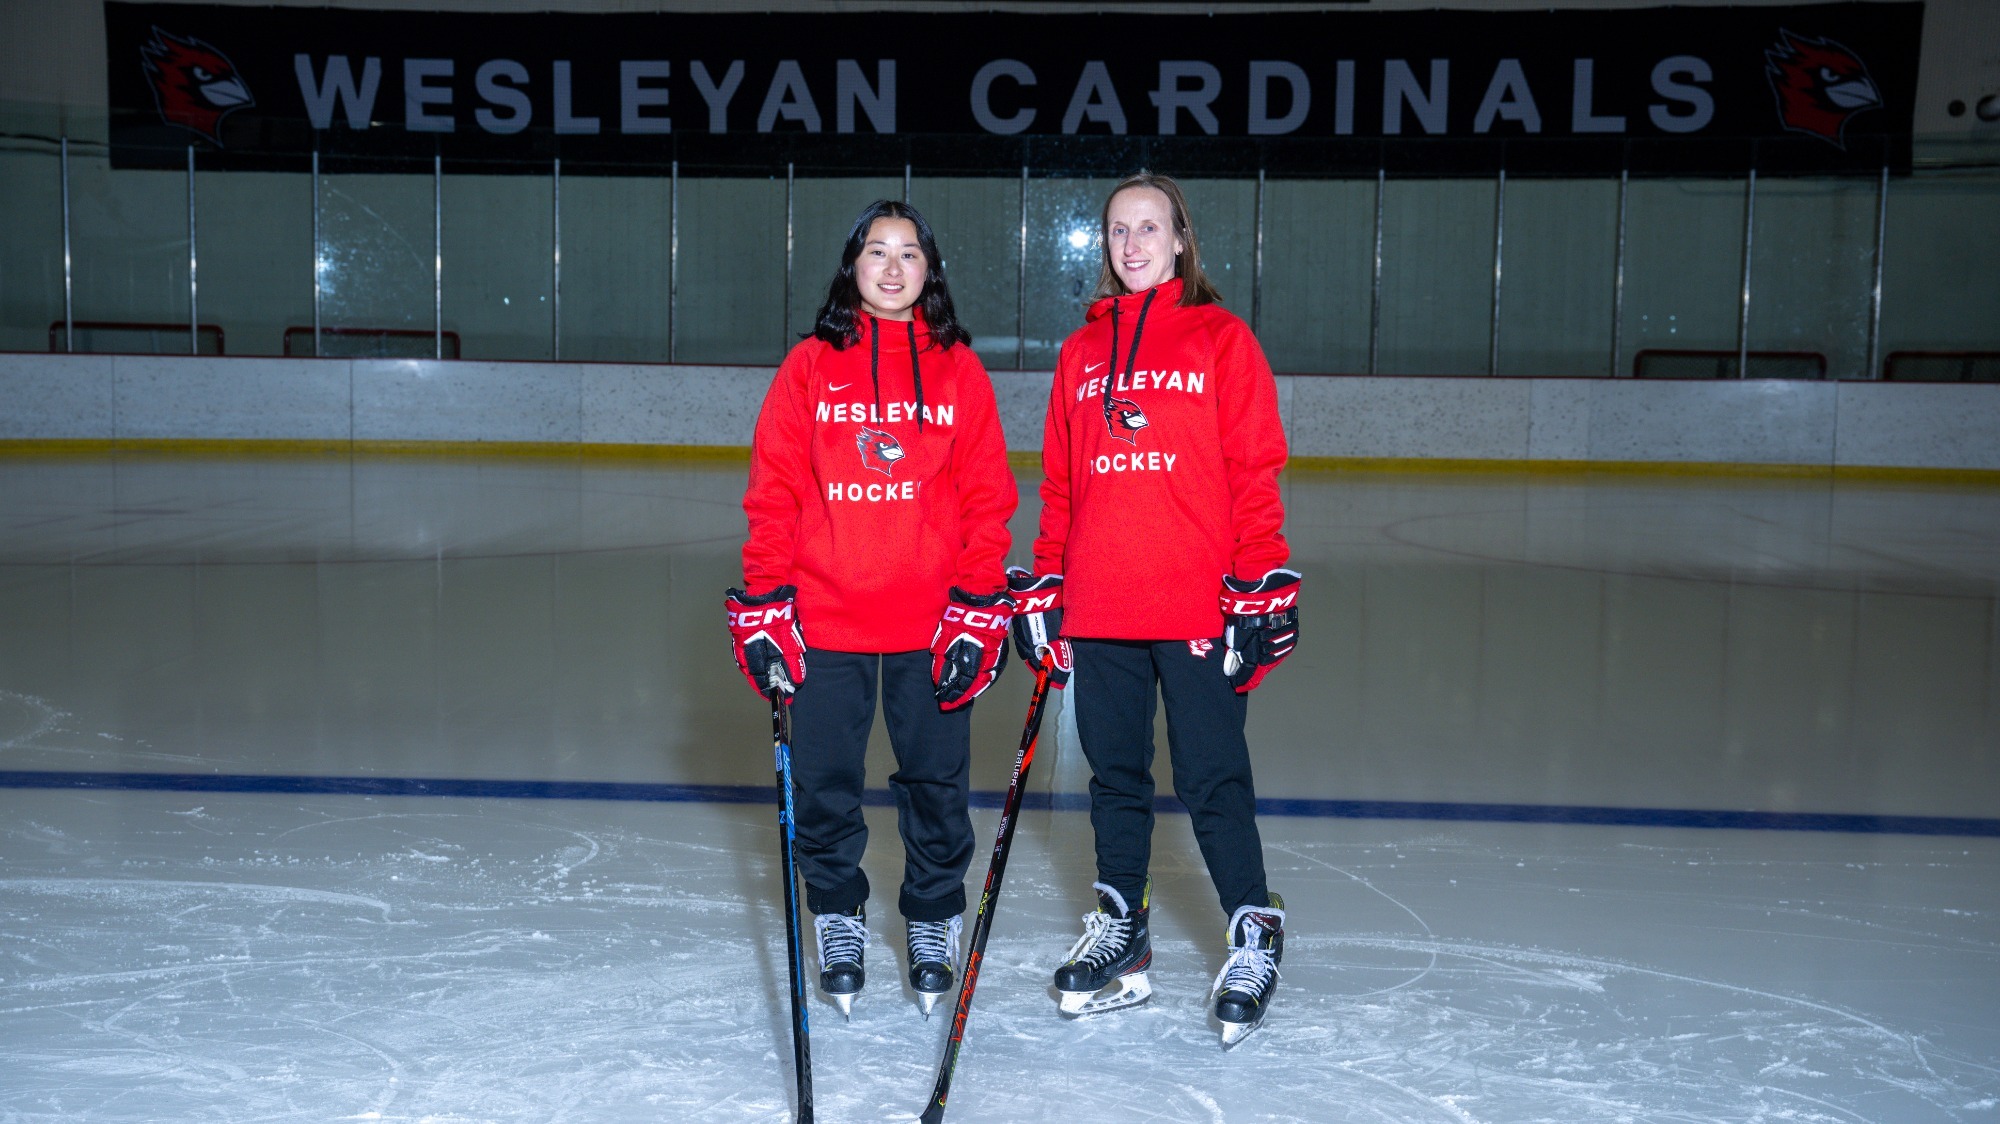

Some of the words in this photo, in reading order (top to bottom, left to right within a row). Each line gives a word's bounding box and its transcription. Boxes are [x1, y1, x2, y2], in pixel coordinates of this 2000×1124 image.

[294, 54, 897, 134] WESLEYAN
[970, 55, 1714, 134] CARDINALS
[1076, 370, 1205, 403] WESLEYAN
[816, 401, 954, 425] WESLEYAN
[1090, 451, 1176, 475] OCKEY
[828, 481, 922, 502] HOCKE
[943, 605, 1013, 631] CCM
[782, 750, 795, 826] BAUER
[950, 951, 982, 1043] VAPOR
